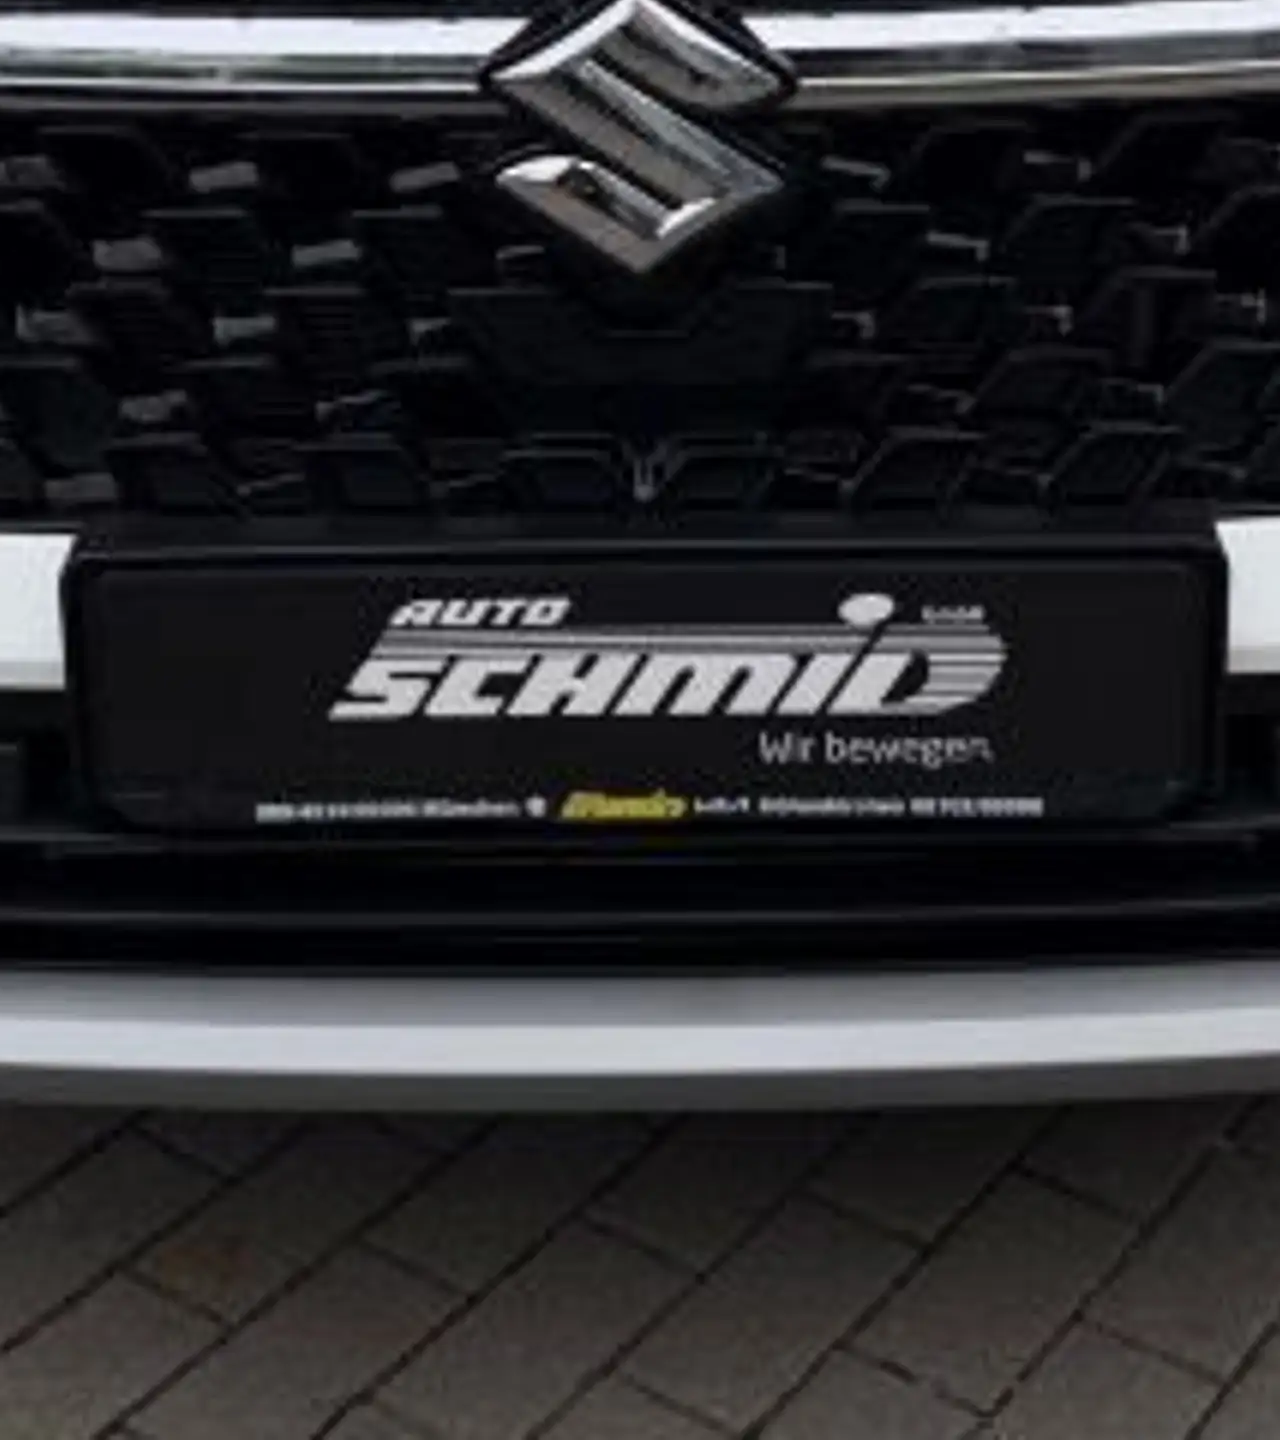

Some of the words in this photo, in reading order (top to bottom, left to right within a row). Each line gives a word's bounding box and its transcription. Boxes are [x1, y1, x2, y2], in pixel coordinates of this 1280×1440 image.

[389, 596, 571, 627] AUTO
[327, 593, 1008, 721] SCHMID
[758, 731, 816, 765] Wir
